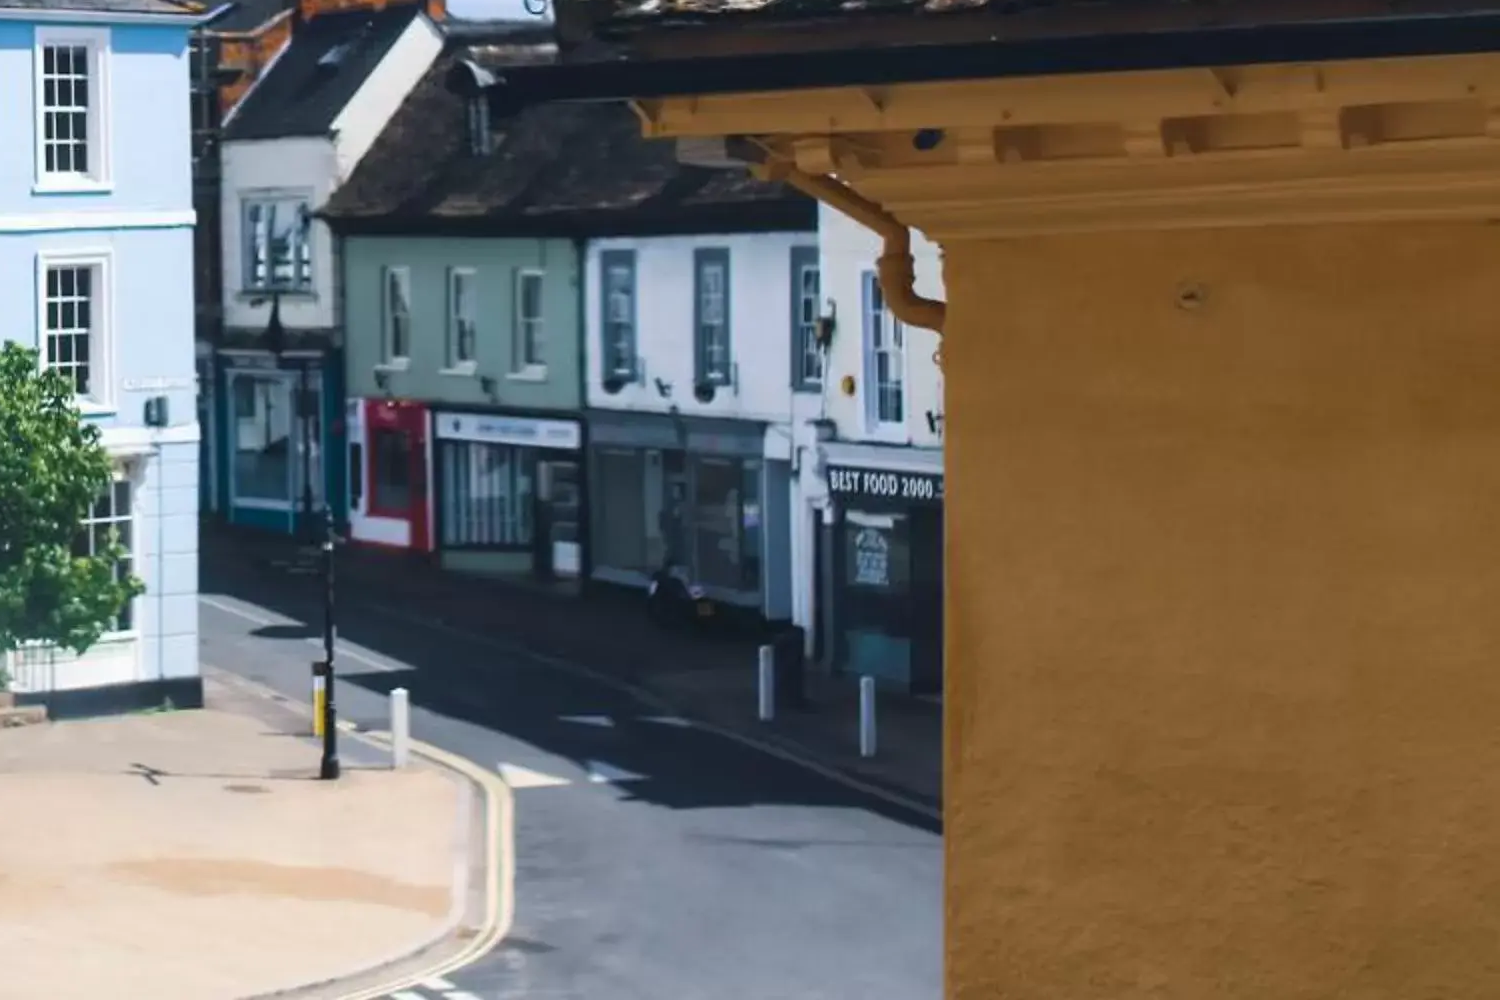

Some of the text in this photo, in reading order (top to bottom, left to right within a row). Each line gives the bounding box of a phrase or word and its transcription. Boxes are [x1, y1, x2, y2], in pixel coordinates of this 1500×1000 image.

[830, 470, 860, 492] BEST
[863, 472, 898, 496] FOOD
[902, 477, 933, 499] 2000
